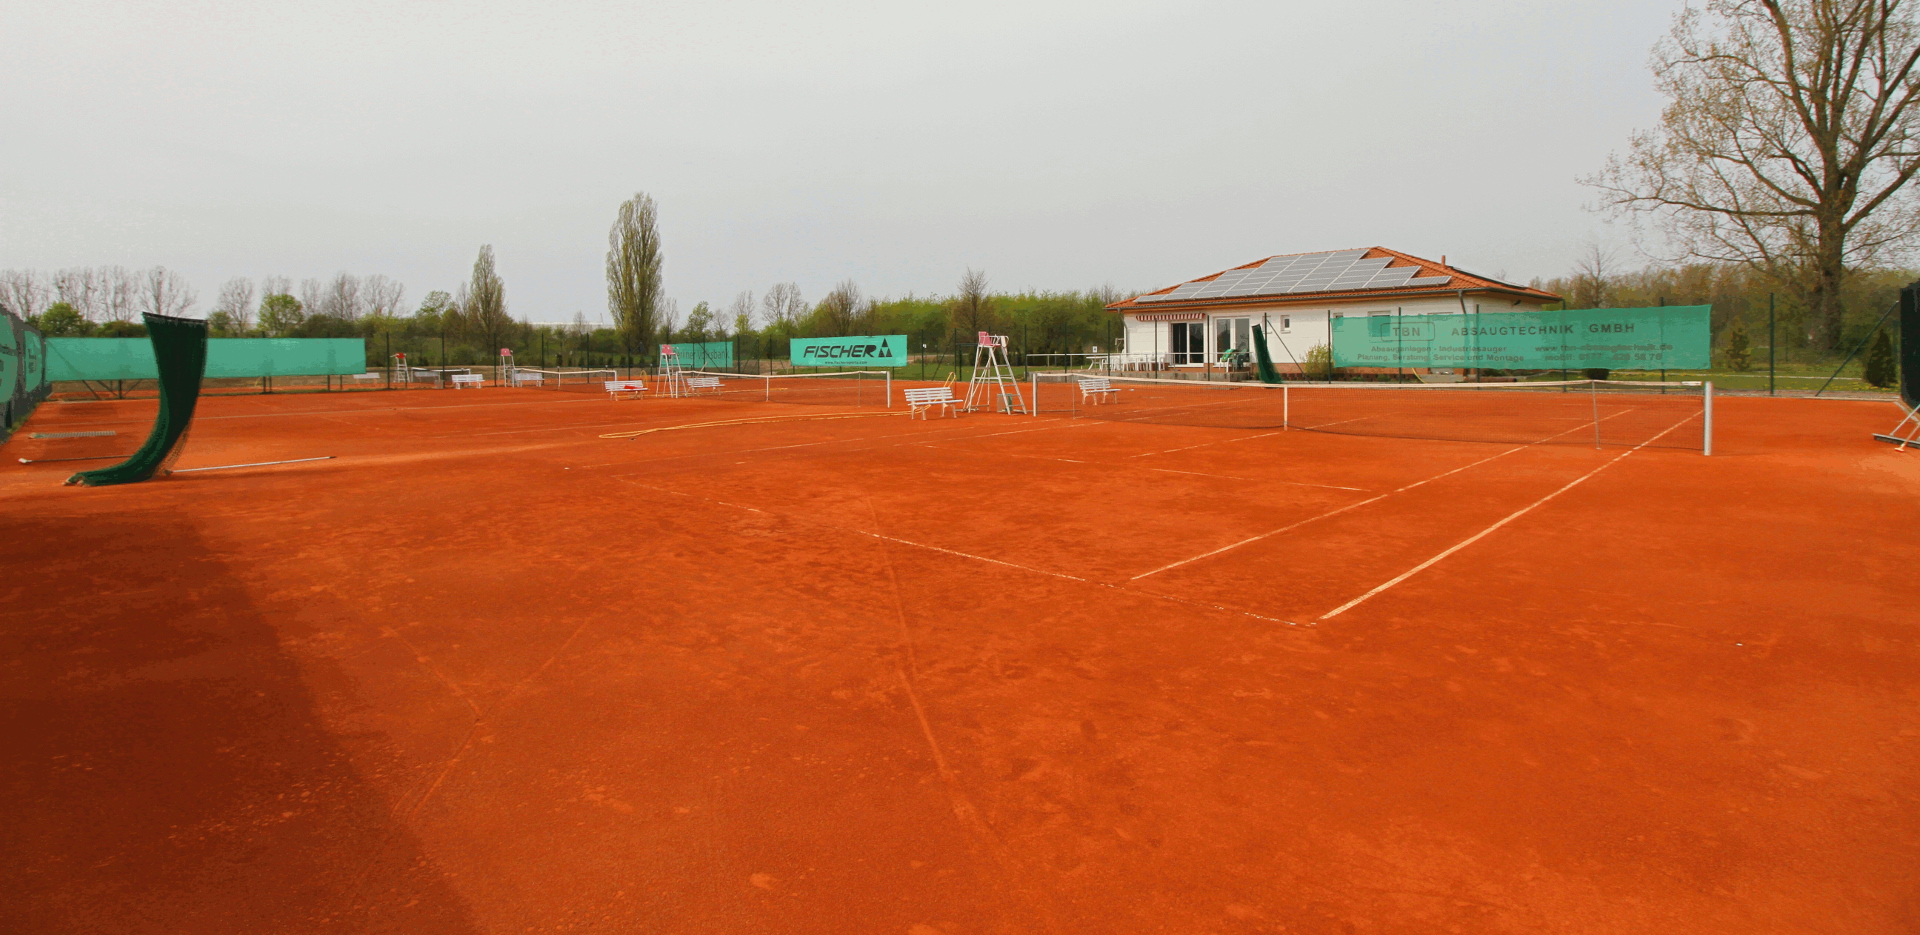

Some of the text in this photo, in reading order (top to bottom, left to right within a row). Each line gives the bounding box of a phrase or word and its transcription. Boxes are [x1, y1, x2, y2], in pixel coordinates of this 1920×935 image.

[1392, 327, 1421, 337] TBN
[1451, 323, 1635, 336] ABSAUGTECHNIK GMBH
[803, 345, 877, 358] FISCHER
[1486, 354, 1524, 363] Montage
